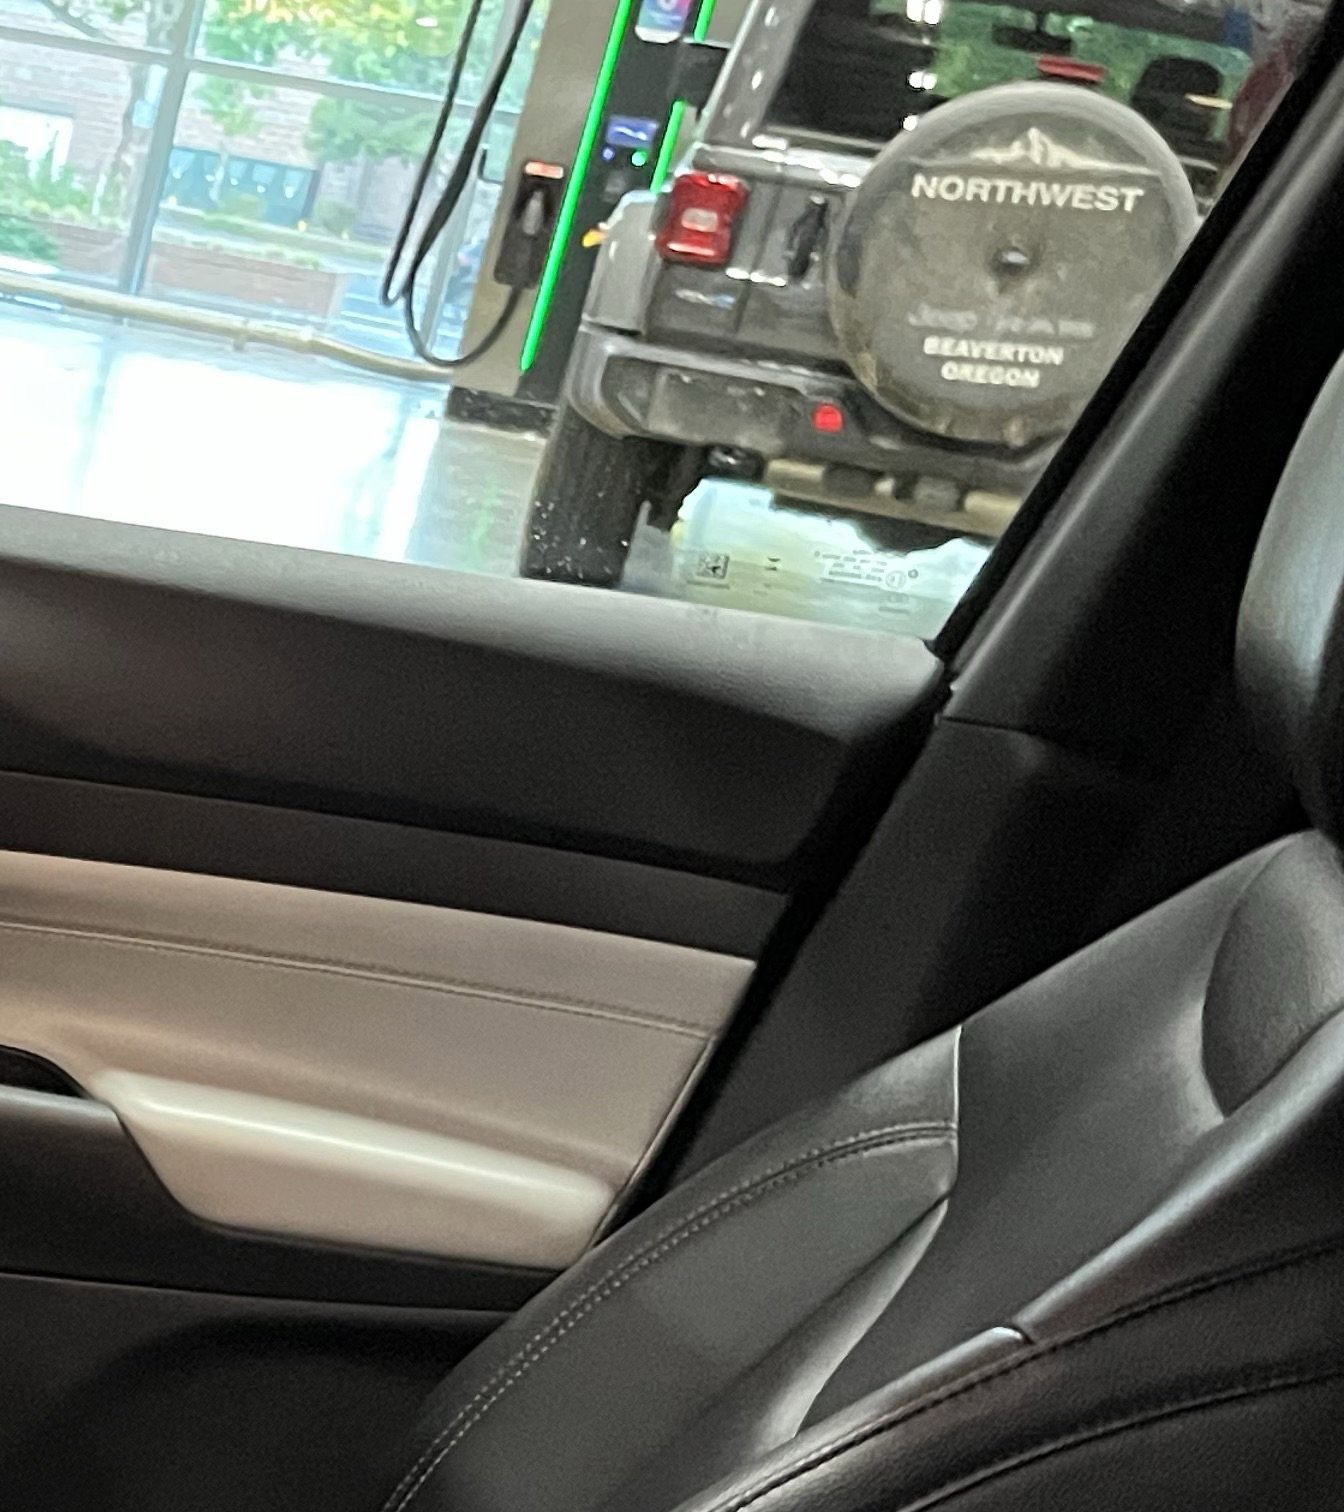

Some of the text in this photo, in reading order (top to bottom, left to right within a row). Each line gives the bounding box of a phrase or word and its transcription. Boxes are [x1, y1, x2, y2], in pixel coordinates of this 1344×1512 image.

[911, 172, 1146, 213] NORTHWEST
[922, 335, 1065, 366] BEAVERTON
[940, 361, 1041, 389] OREGON
